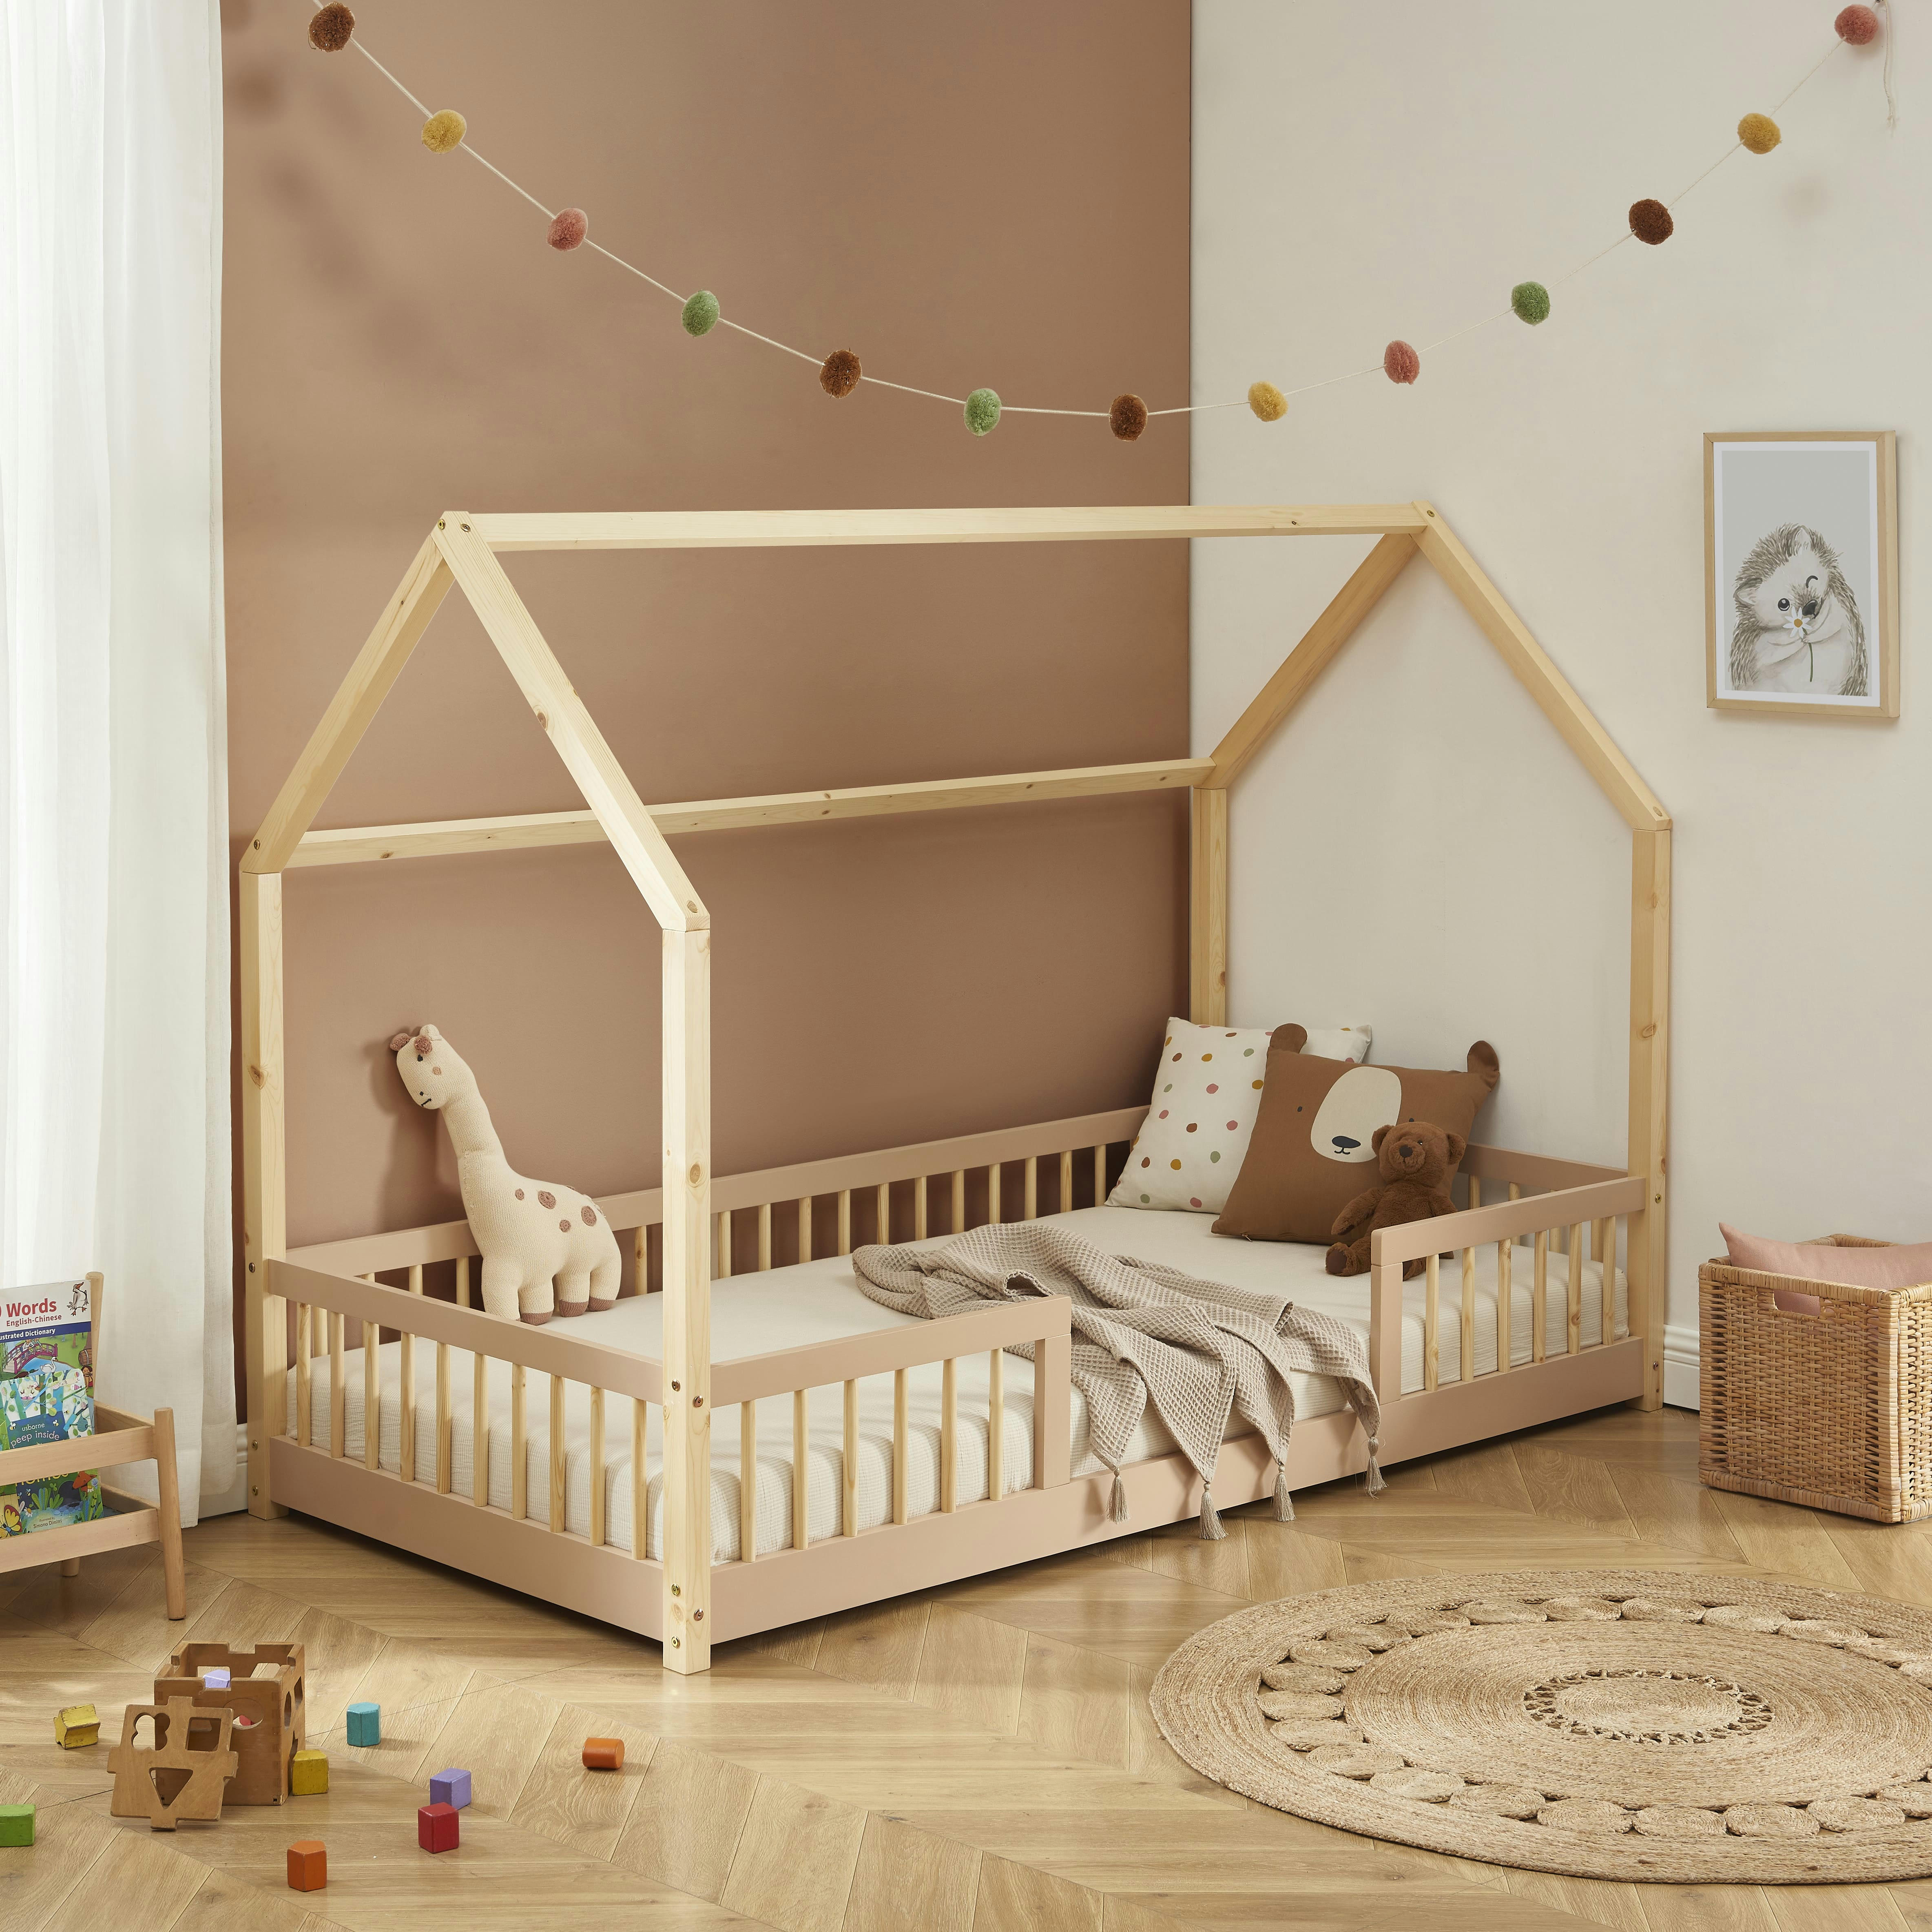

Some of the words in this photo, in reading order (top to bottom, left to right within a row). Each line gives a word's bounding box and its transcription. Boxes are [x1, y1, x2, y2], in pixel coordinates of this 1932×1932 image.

[6, 1298, 57, 1317] Words
[7, 1315, 62, 1327] English-Chinese
[25, 1328, 55, 1337] Dictionary
[22, 1423, 45, 1431] usborne
[11, 1434, 32, 1448] peep
[35, 1431, 60, 1440] inside
